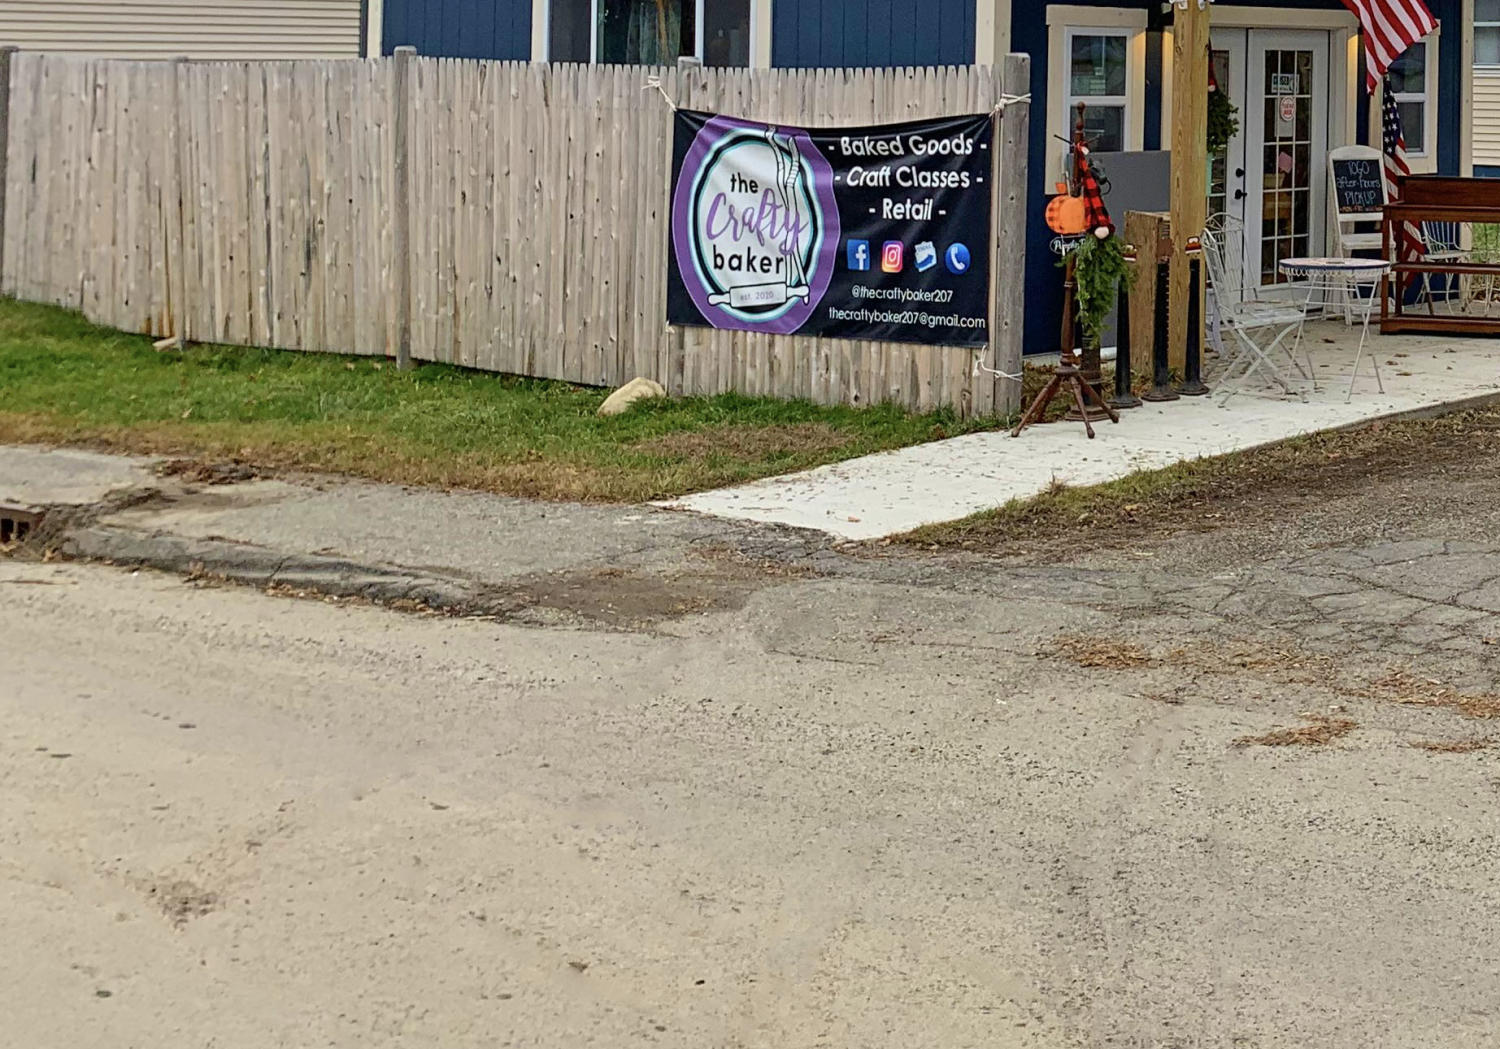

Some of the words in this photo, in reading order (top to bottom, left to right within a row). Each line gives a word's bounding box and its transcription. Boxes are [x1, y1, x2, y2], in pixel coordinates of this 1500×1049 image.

[840, 136, 905, 156] Baked
[908, 133, 973, 156] Goods
[730, 172, 759, 194] the
[846, 165, 891, 187] Craft
[895, 165, 970, 189] Classes
[882, 197, 934, 221] Retail
[706, 187, 809, 256] Crafty
[712, 243, 785, 274] baker
[851, 284, 954, 303] @thecraftybaker207
[828, 306, 986, 329] thecraftybaker207@gmail.com
